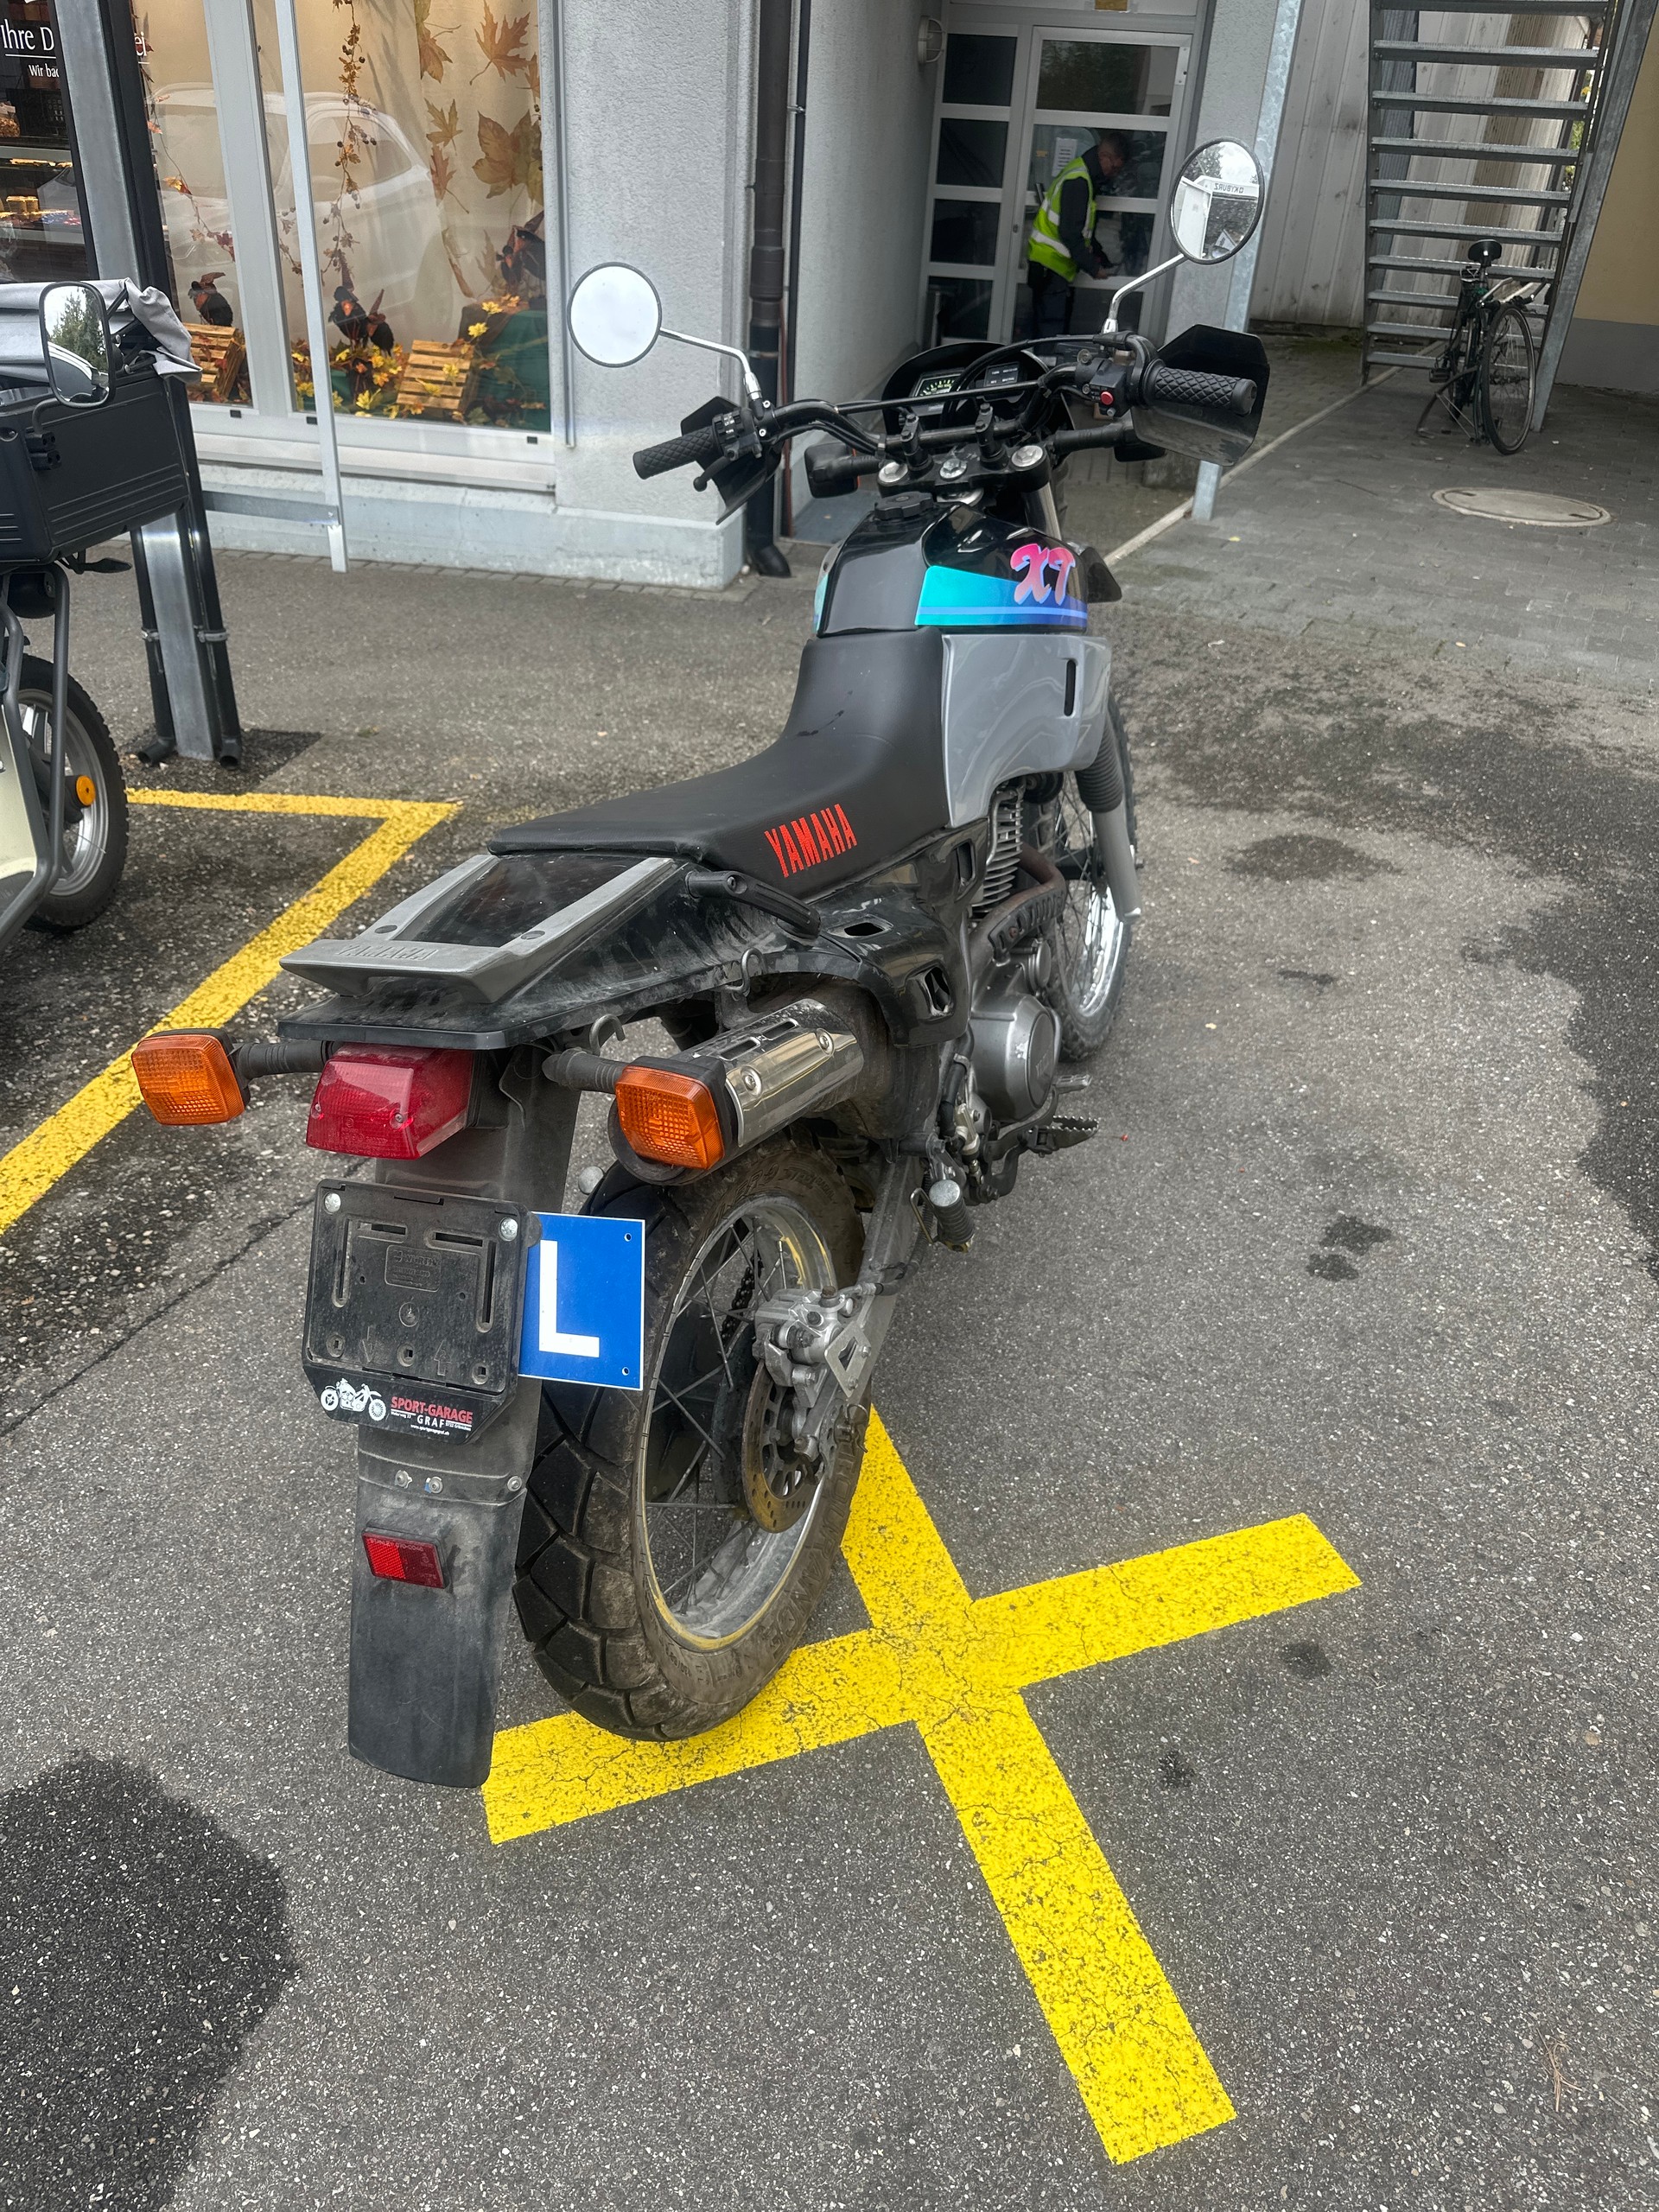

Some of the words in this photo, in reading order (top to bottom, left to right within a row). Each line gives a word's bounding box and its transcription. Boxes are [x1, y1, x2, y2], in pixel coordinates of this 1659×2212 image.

[0, 18, 35, 50] Ihre
[29, 64, 44, 77] Wir
[1010, 543, 1076, 606] XT
[764, 804, 858, 879] YAMAHA
[335, 944, 439, 962] YAMAHA
[538, 1240, 600, 1357] L
[391, 1395, 474, 1425] SPORT-GARAGE
[416, 1414, 445, 1428] GRAF
